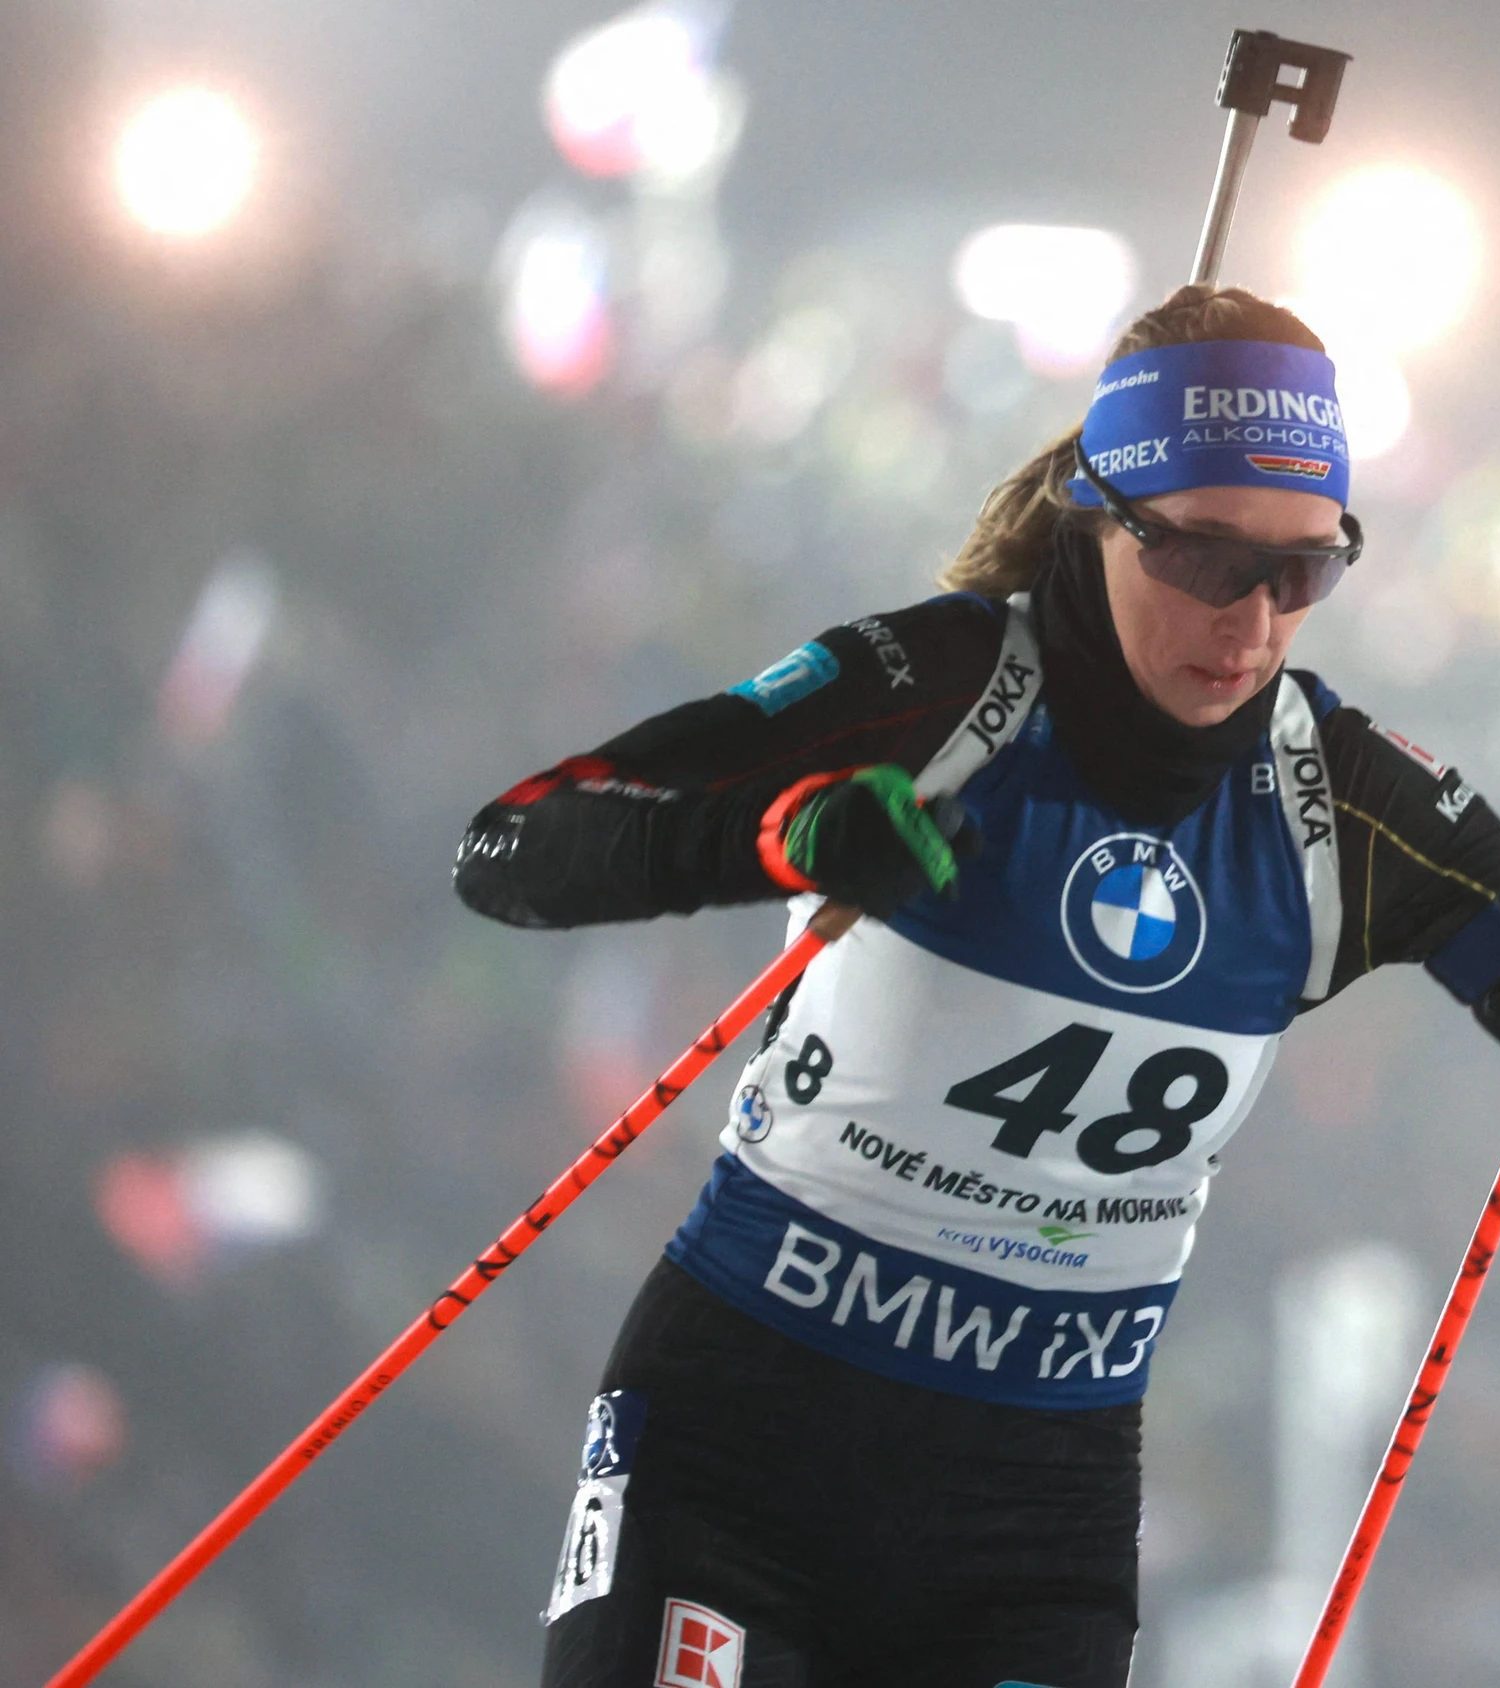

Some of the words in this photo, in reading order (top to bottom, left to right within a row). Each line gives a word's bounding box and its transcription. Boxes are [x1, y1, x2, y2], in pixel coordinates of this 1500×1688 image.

[966, 662, 1035, 755] JOKA
[1283, 744, 1331, 849] JOKA
[1091, 841, 1187, 893] BMW
[942, 1021, 1229, 1176] 48
[838, 1121, 928, 1181] NOVÉ
[922, 1164, 1041, 1213] MĚSTO
[1042, 1199, 1087, 1223] NA
[763, 1222, 1031, 1371] BMW
[1038, 1305, 1165, 1380] iX3
